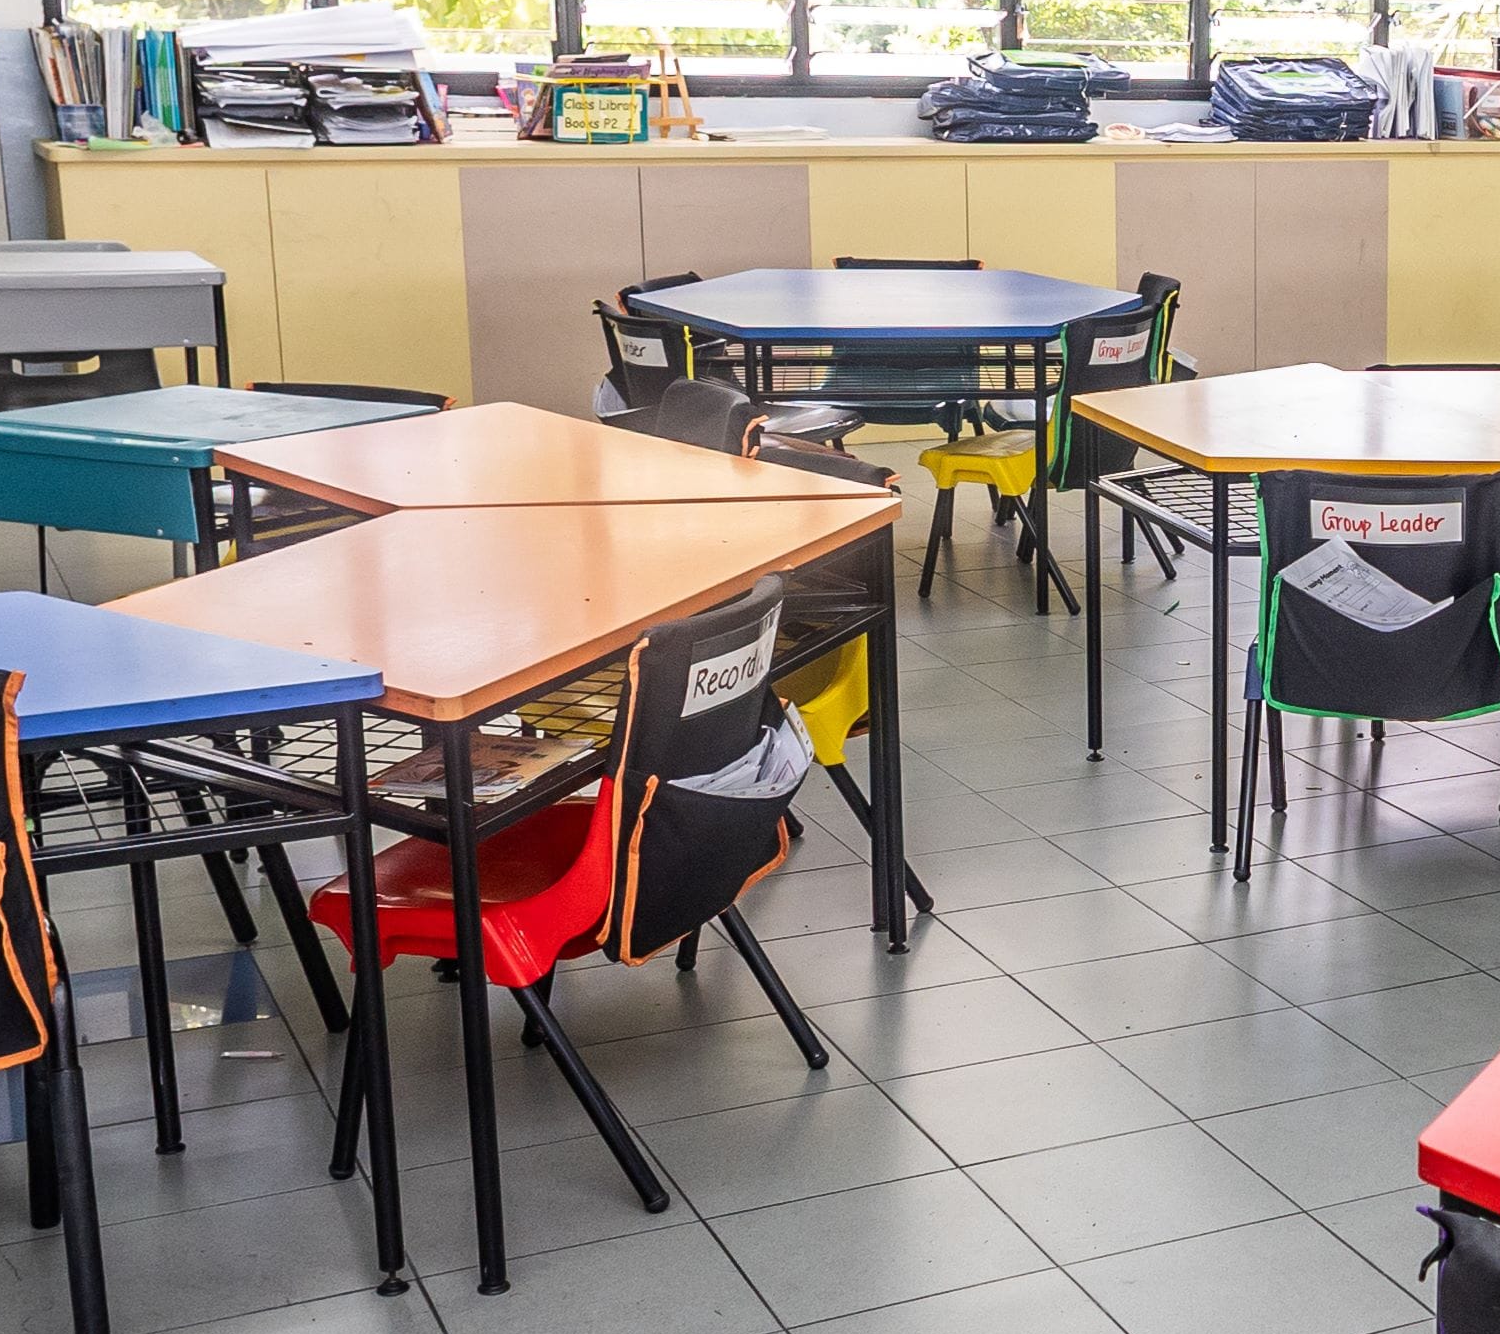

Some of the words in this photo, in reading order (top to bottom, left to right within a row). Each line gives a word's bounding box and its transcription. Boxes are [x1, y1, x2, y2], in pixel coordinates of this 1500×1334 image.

[564, 98, 594, 111] Class
[599, 99, 638, 112] Library
[1321, 506, 1372, 540] Group
[1380, 510, 1446, 533] Leader
[692, 647, 764, 700] Record
